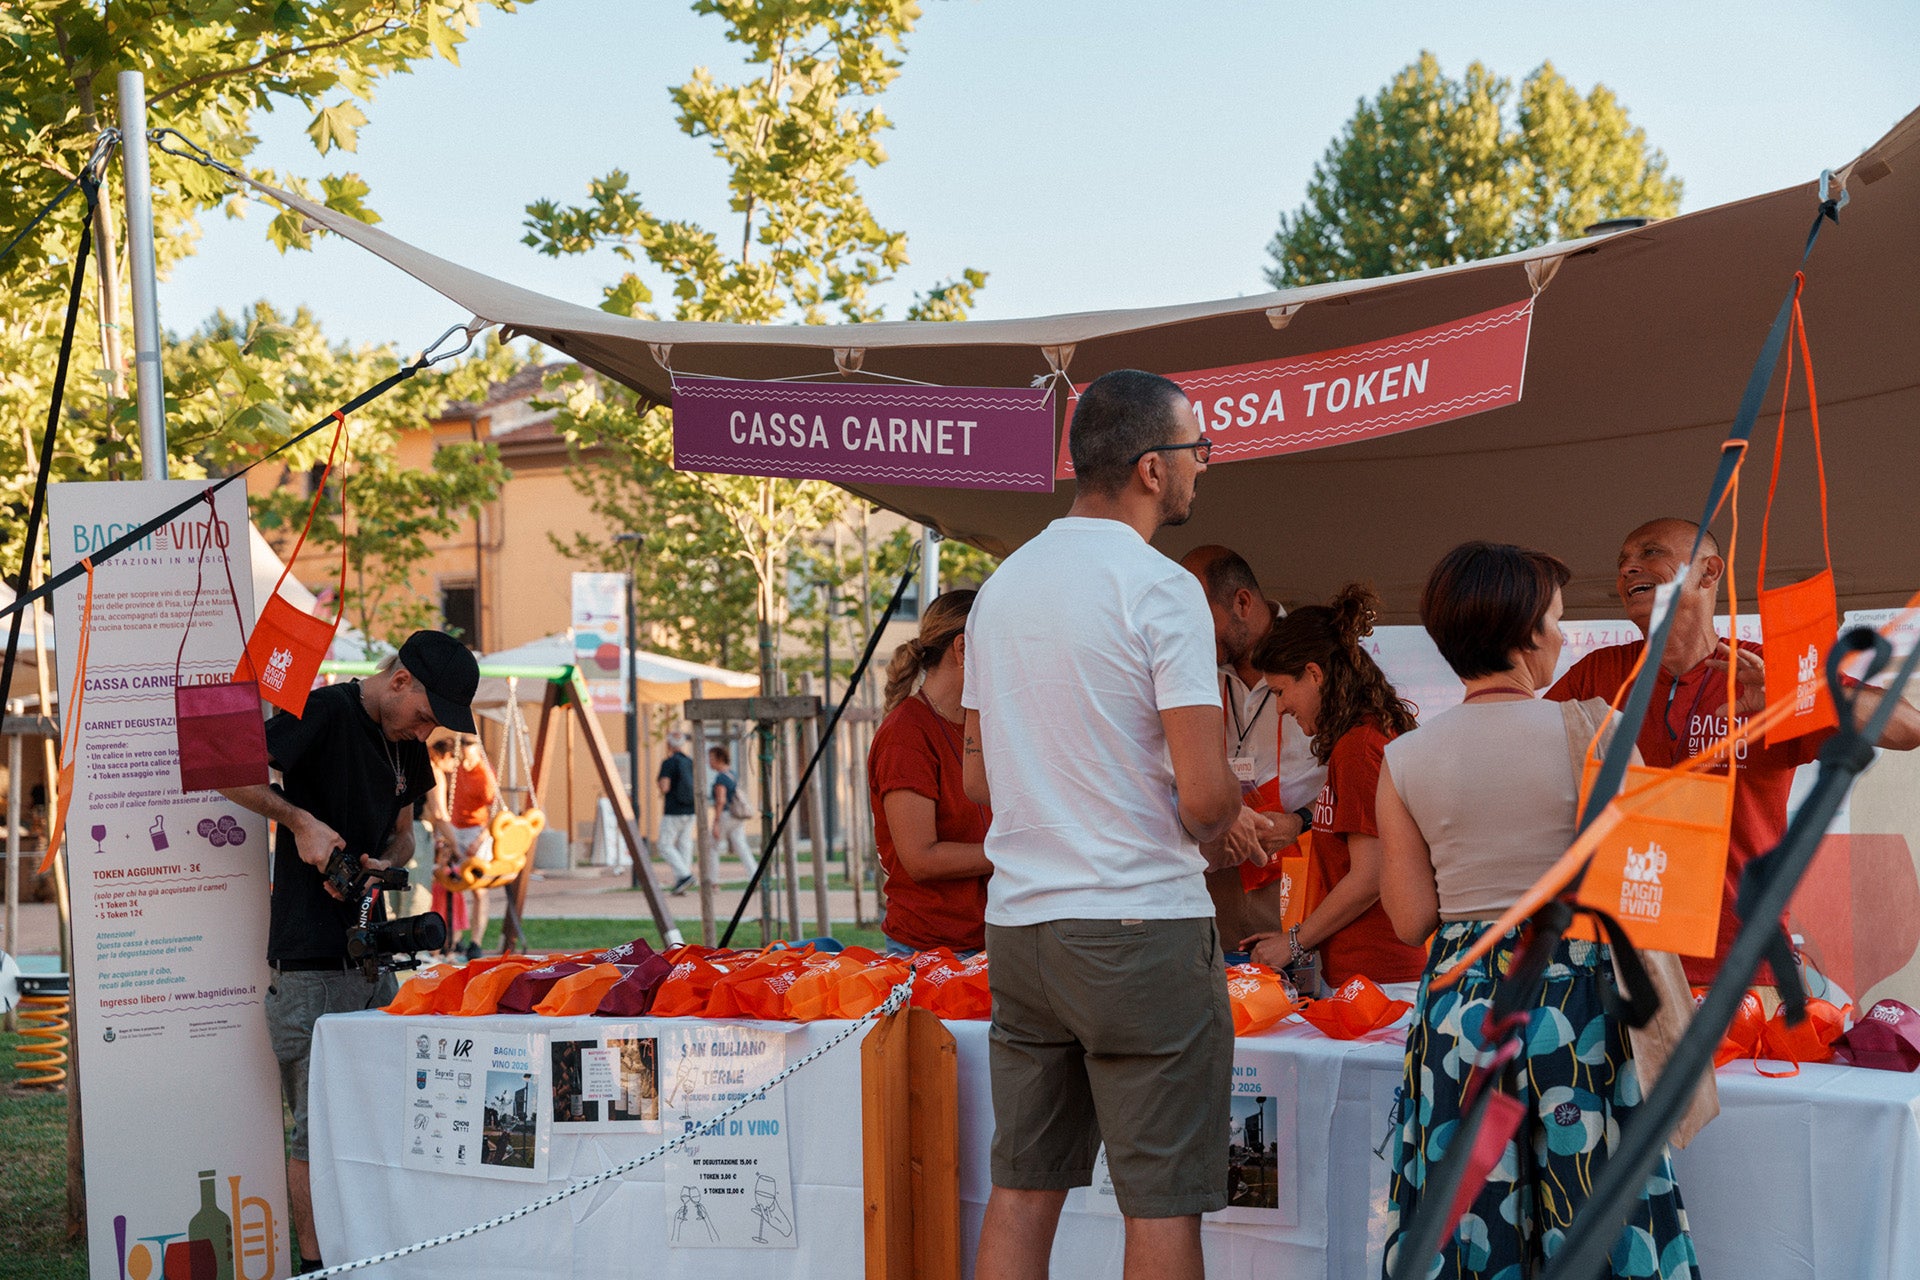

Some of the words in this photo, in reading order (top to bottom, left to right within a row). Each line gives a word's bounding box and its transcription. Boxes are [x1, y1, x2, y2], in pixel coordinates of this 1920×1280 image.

[1193, 387, 1286, 434] ASSA
[1303, 358, 1430, 419] TOKEN
[729, 410, 830, 449] CASSA
[842, 416, 978, 457] CARNET
[170, 521, 230, 550] VINO
[84, 677, 129, 692] CASSA
[133, 674, 185, 690] CARNET
[85, 720, 123, 731] CARNET
[86, 742, 129, 752] Comprende:
[1689, 737, 1699, 748] DI
[92, 753, 101, 761] Un
[103, 751, 124, 760] calice
[134, 751, 153, 759] vetro
[92, 763, 106, 771] Una
[108, 762, 128, 770] sacca
[130, 761, 149, 769] porta
[151, 759, 171, 768] calice
[93, 772, 98, 780] 4
[100, 771, 121, 780] Token
[122, 770, 154, 779] assaggio
[155, 769, 170, 777] vino
[94, 791, 126, 802] possibile
[128, 790, 161, 800] degustare
[89, 802, 104, 810] solo
[106, 802, 118, 810] con
[126, 800, 147, 808] calice
[148, 798, 171, 807] fornito
[172, 797, 200, 805] assieme
[202, 795, 209, 803] al
[93, 869, 125, 880] TOKEN
[127, 865, 181, 878] AGGIUNTIVI
[190, 863, 201, 873] 3€
[94, 892, 112, 901] (solo
[113, 891, 125, 900] per
[126, 889, 137, 898] chi
[138, 889, 147, 897] ha
[161, 885, 197, 896] acquistato
[1621, 881, 1664, 902] BAGNI
[107, 901, 128, 909] Token
[1628, 898, 1661, 918] VINO
[107, 911, 128, 919] Token
[130, 909, 143, 917] 12€
[360, 896, 374, 929] RONIN
[97, 942, 121, 950] Questa
[99, 971, 111, 980] Per
[112, 969, 149, 979] acquistare
[100, 981, 120, 990] recati
[121, 979, 133, 988] alle
[135, 978, 155, 987] casse
[100, 998, 139, 1009] Ingresso
[141, 995, 166, 1004] libero
[175, 984, 257, 1001] www.bagnidivino.it
[494, 1047, 517, 1057] BAGNI
[681, 1043, 706, 1058] SAN
[711, 1041, 767, 1057] GIULIANO
[492, 1060, 510, 1069] VINO
[512, 1061, 529, 1071] 2026
[1246, 1067, 1257, 1077] DI
[1238, 1082, 1262, 1093] 2026
[730, 1120, 743, 1136] DI
[748, 1119, 780, 1137] VINO
